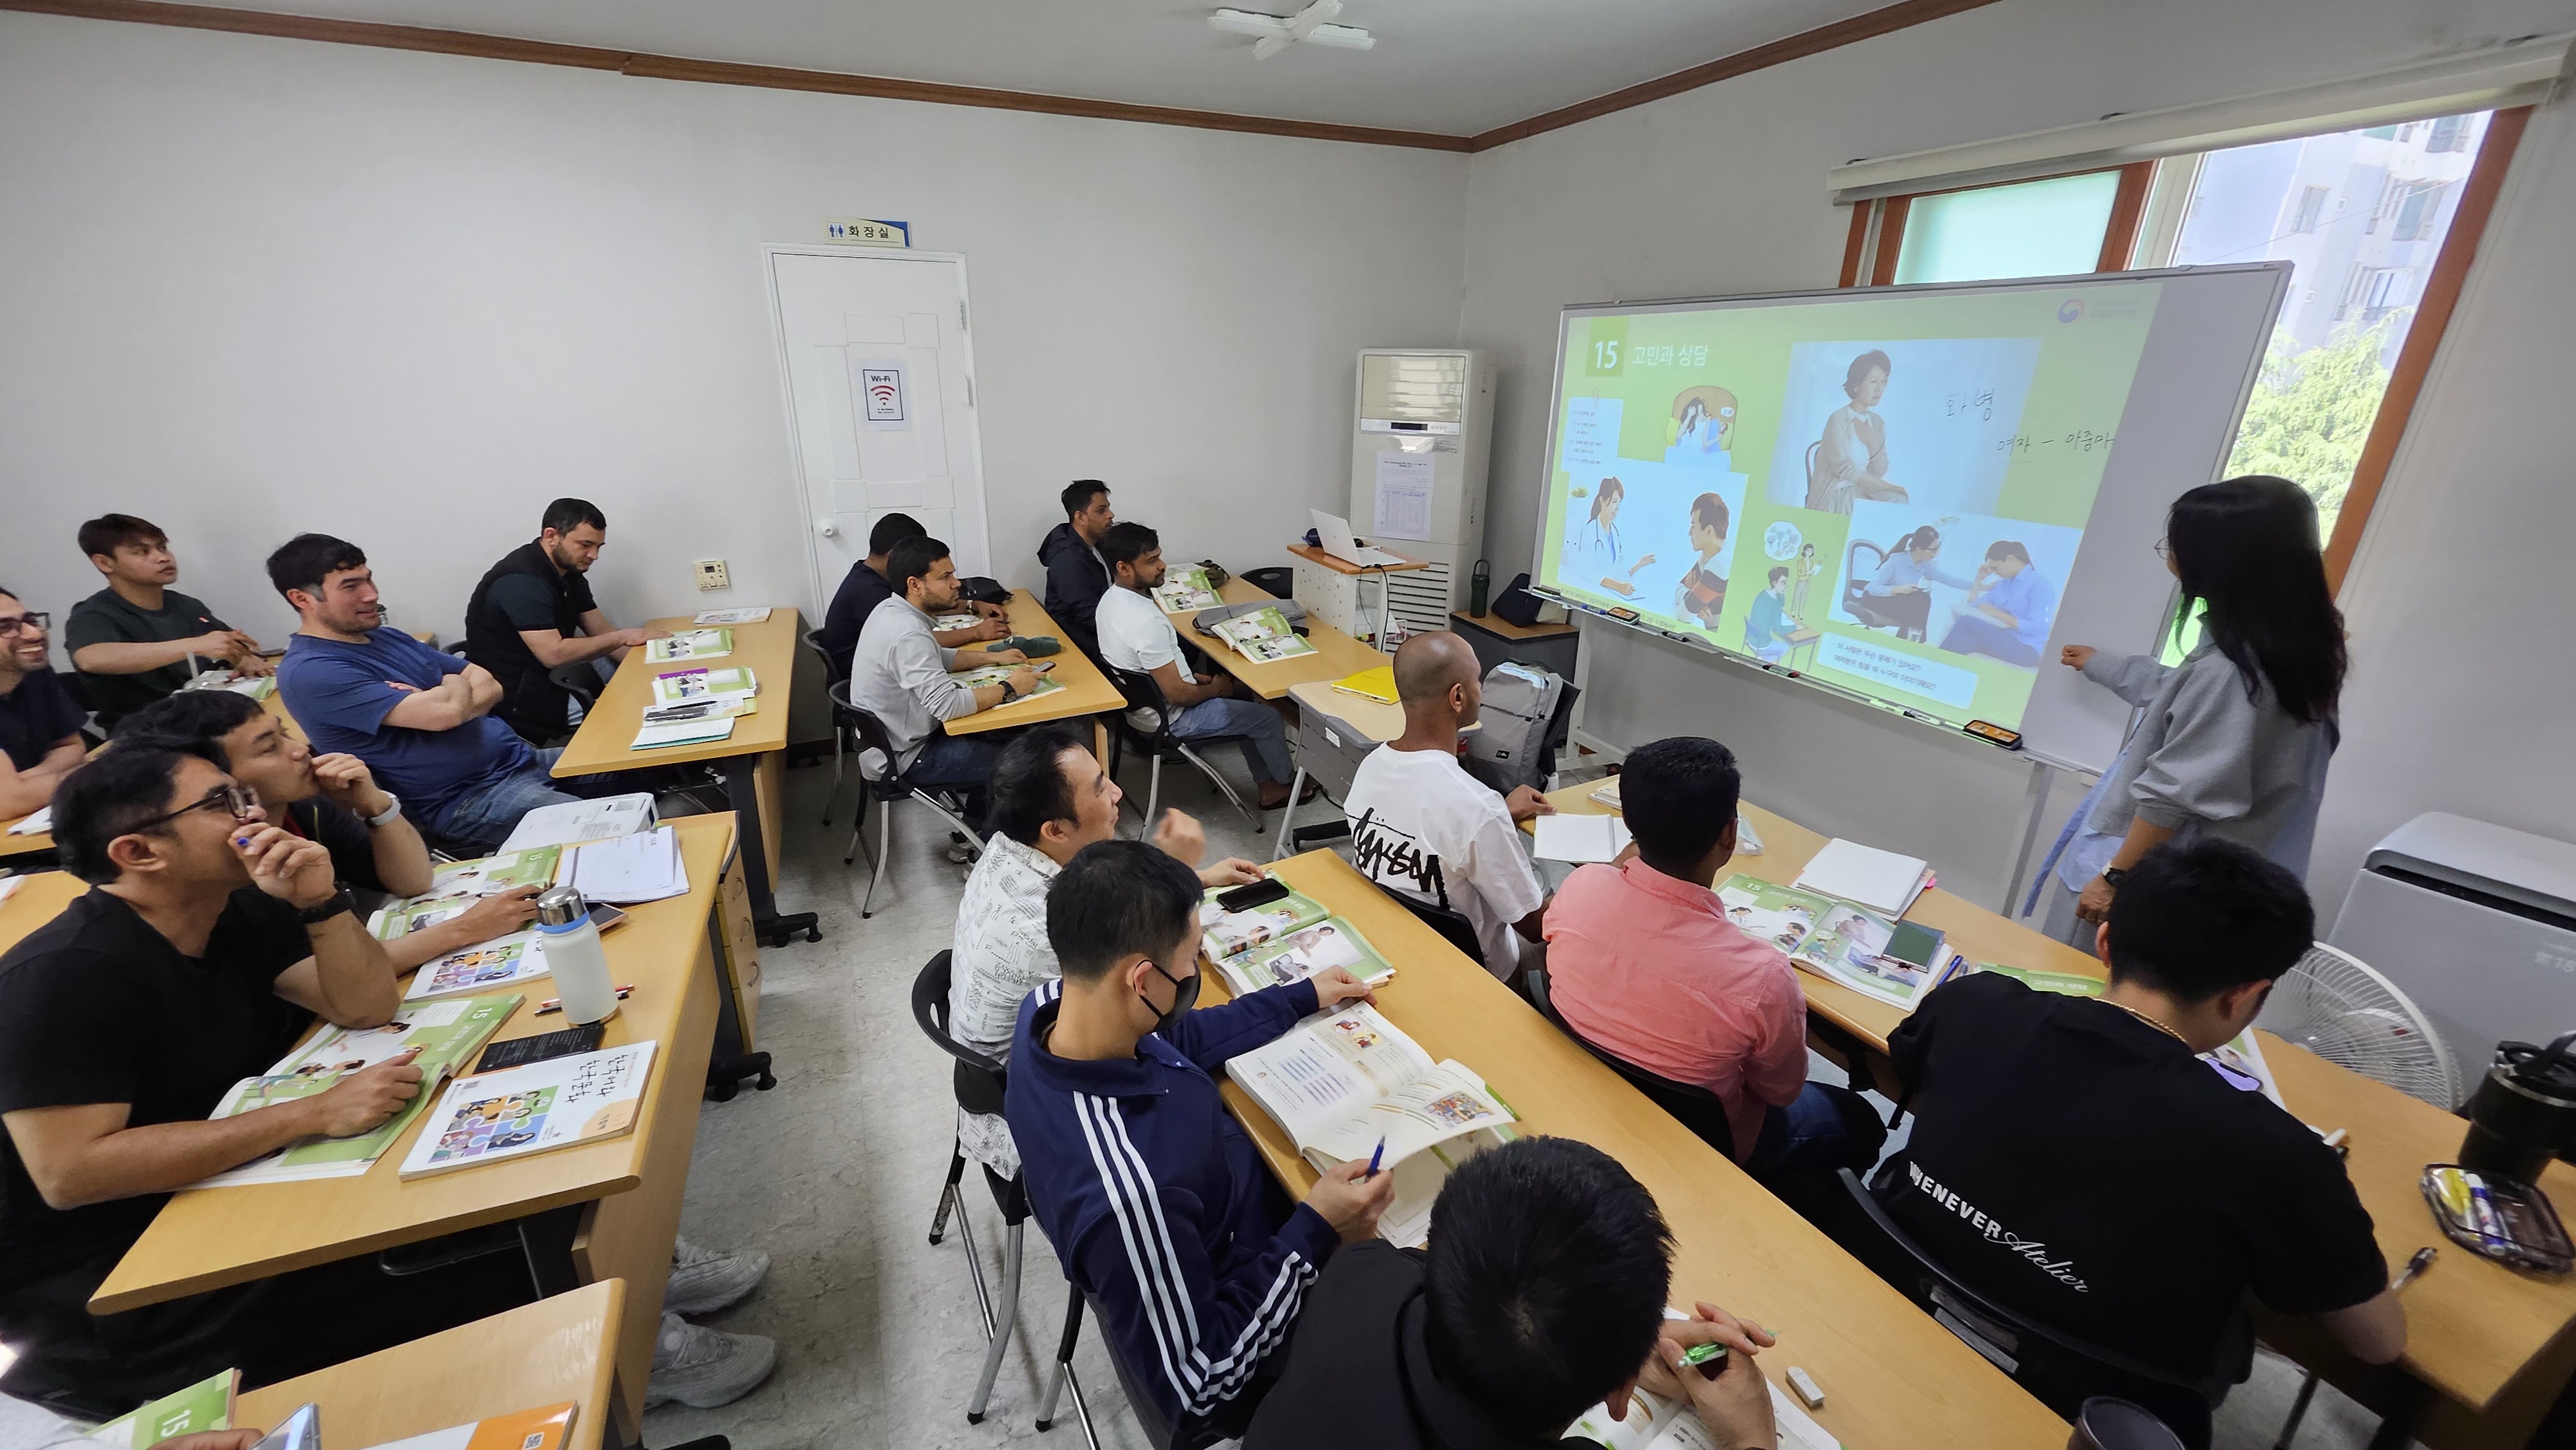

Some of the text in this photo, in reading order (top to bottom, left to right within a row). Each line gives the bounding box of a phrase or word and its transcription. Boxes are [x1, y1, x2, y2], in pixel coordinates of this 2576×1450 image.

[848, 225, 889, 239] 화장실
[1595, 340, 1618, 369] 15
[1632, 345, 1710, 367] 고민과 상담
[1996, 433, 2031, 456] 여자
[1747, 883, 1762, 891] 15
[472, 1008, 493, 1019] 15
[565, 1060, 601, 1104] 한국문화
[596, 1054, 629, 1098] 한국어와
[1983, 1231, 2088, 1293] Atelier
[161, 1409, 191, 1437] 15
